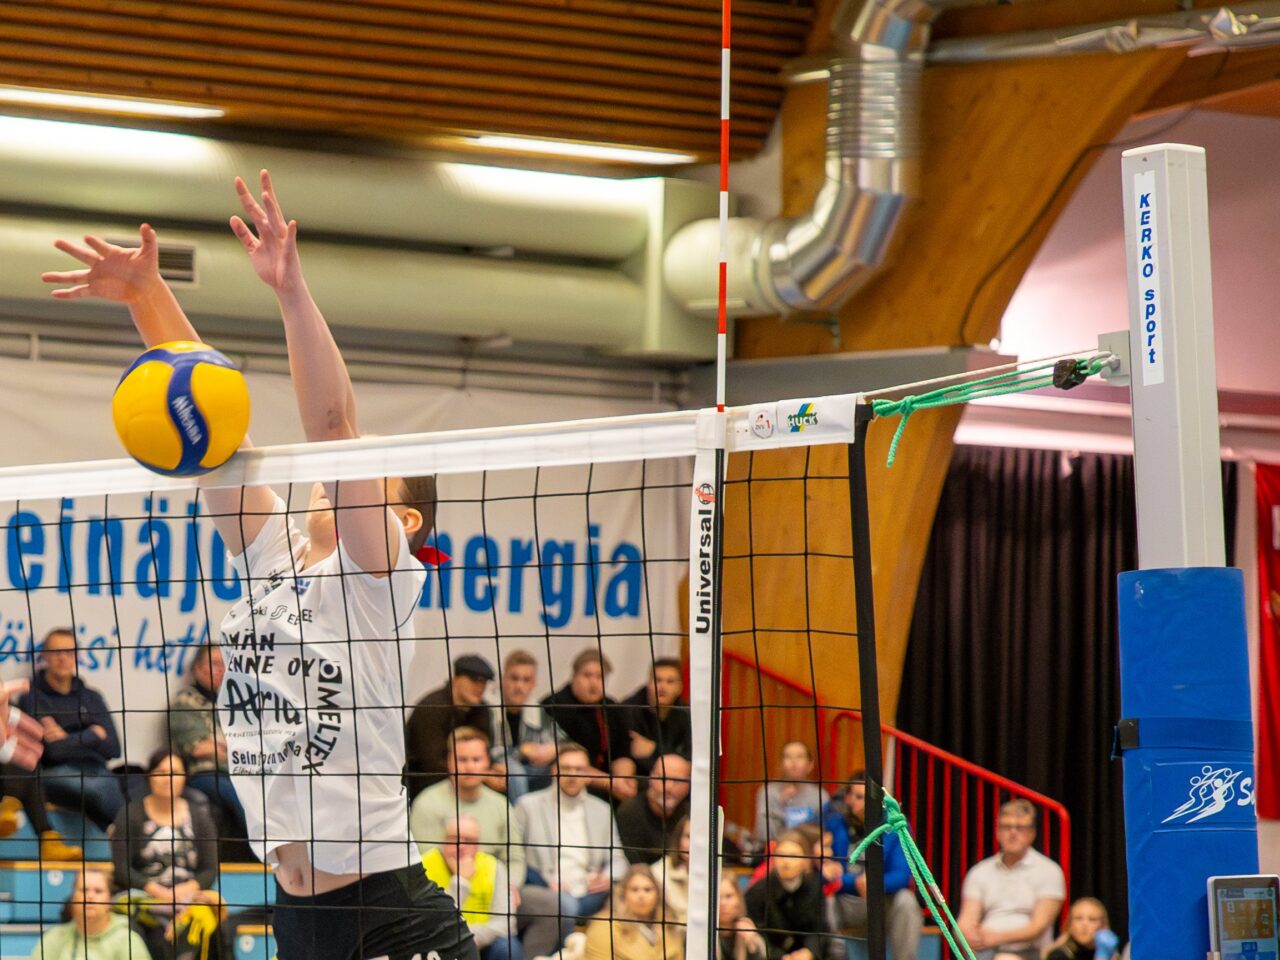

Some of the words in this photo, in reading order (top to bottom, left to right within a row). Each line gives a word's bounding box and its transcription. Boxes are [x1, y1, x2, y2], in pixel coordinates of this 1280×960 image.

[1139, 193, 1154, 278] KERKO
[1144, 288, 1157, 364] sport
[787, 413, 818, 428] HUCK
[417, 523, 642, 629] nergia
[695, 508, 712, 634] Universal
[287, 657, 316, 677] OY
[301, 686, 342, 777] MELTEX
